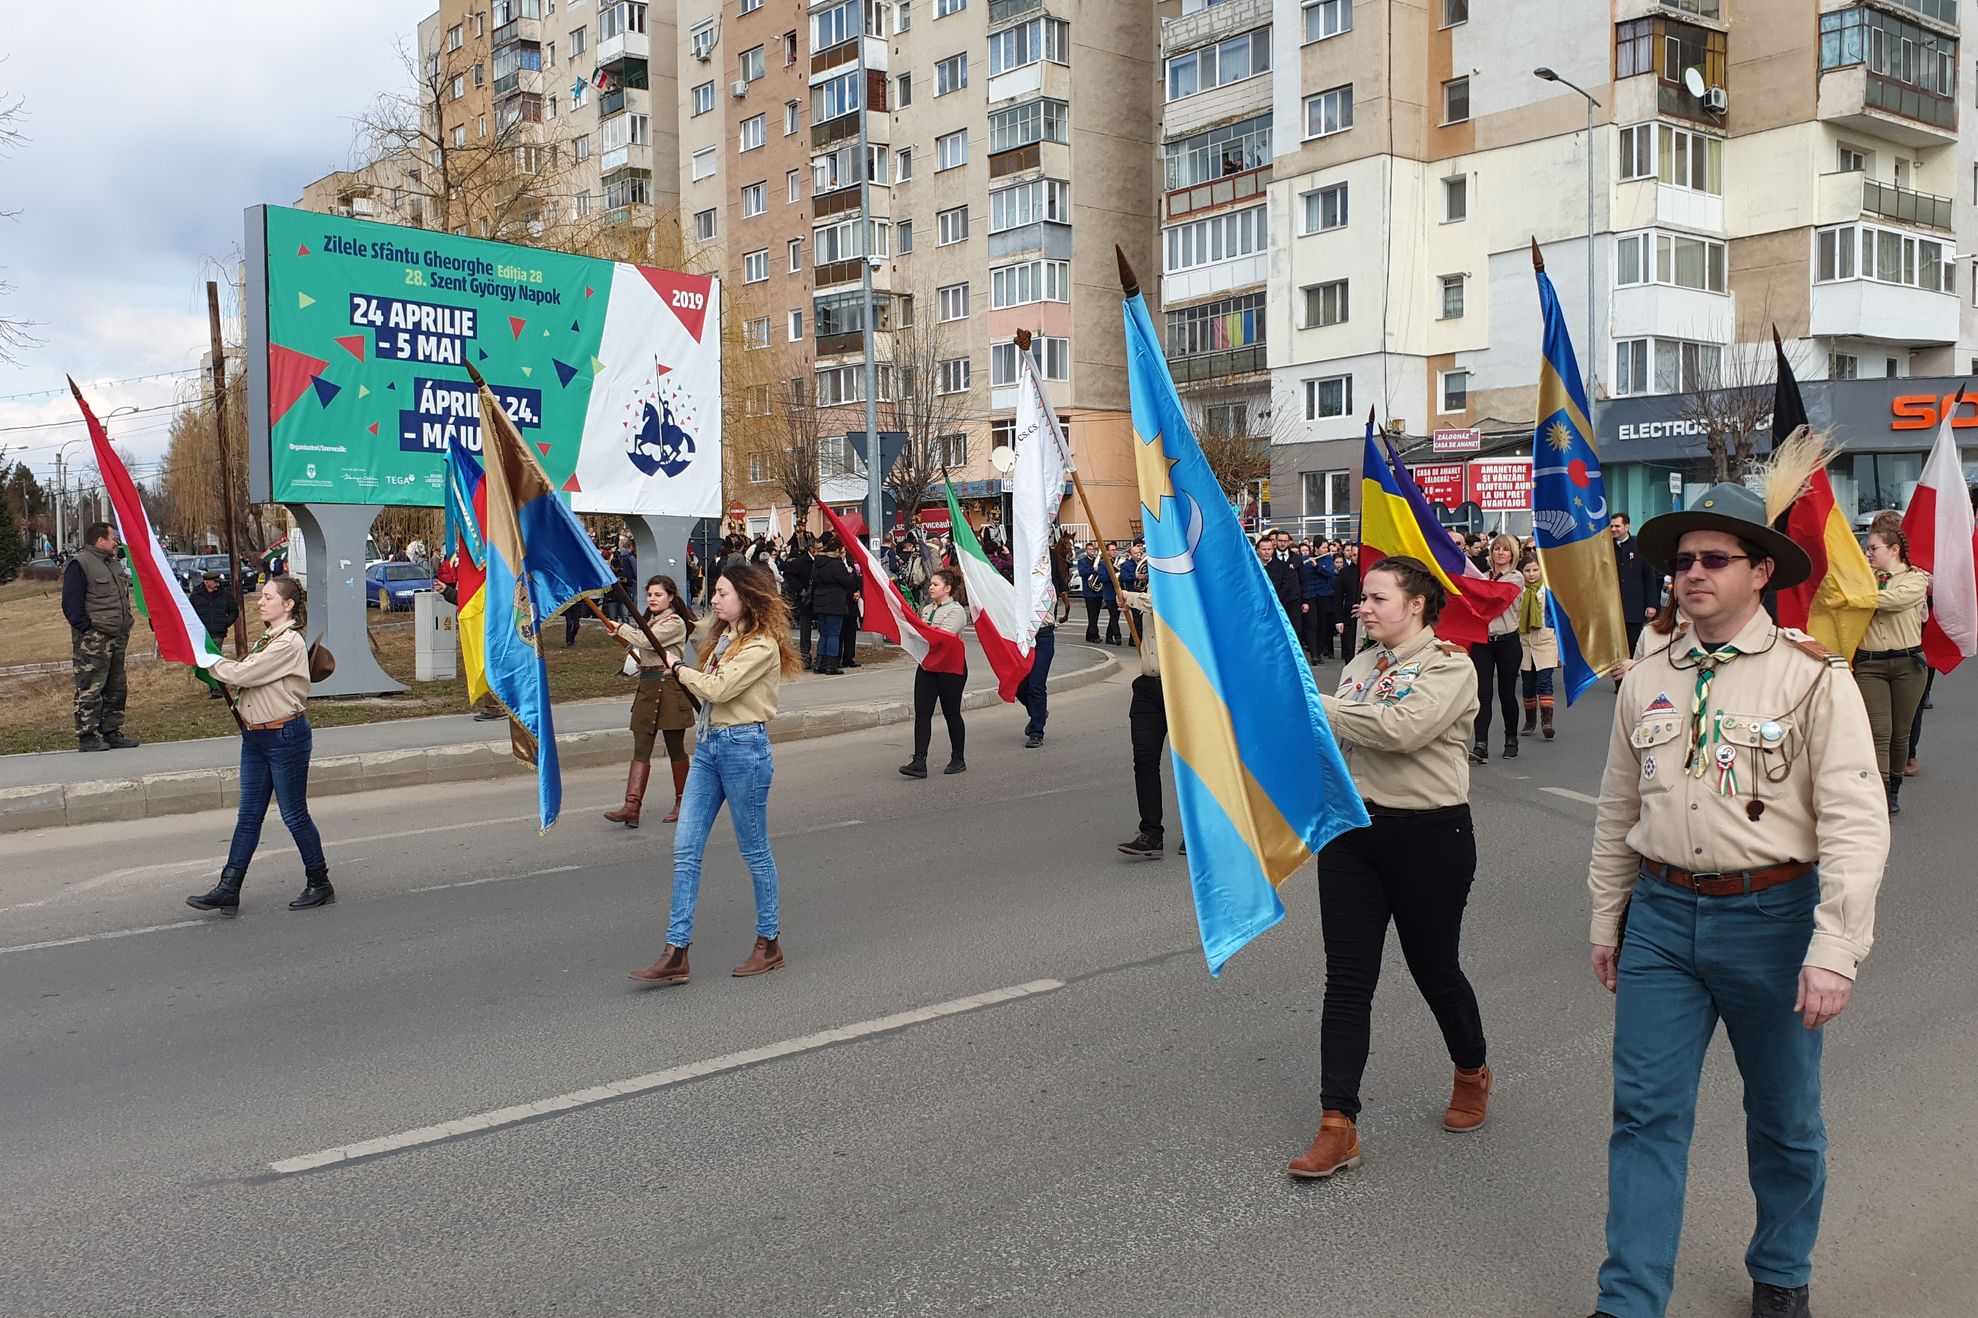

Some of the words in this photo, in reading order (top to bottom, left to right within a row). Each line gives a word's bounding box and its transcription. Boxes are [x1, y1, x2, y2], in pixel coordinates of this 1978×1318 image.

[323, 234, 367, 258] Zilele
[371, 241, 420, 266] Sfântu
[423, 250, 494, 277] Gheorghe
[529, 269, 543, 283] 28
[404, 268, 427, 287] 28.
[430, 271, 468, 293] Szent
[469, 278, 517, 302] György
[519, 284, 561, 306] Napok
[672, 289, 704, 310] 2019
[353, 296, 384, 327] 24
[388, 301, 474, 337] APRILIE
[397, 331, 412, 359] 5
[417, 334, 461, 365] MAI
[506, 396, 539, 424] 24.
[1434, 441, 1449, 449] CASA
[1456, 439, 1478, 448] AMANET
[1417, 468, 1431, 477] CASA
[1431, 468, 1439, 476] DE
[1440, 466, 1461, 475] AMANET
[1481, 465, 1527, 474] AMANETARE
[386, 475, 411, 485] TEGA
[1476, 482, 1513, 491] BIJUTERII
[1515, 481, 1531, 490] AUR
[1482, 490, 1492, 499] LA
[1494, 490, 1505, 499] UN
[1481, 498, 1526, 507] AVANTAJOS
